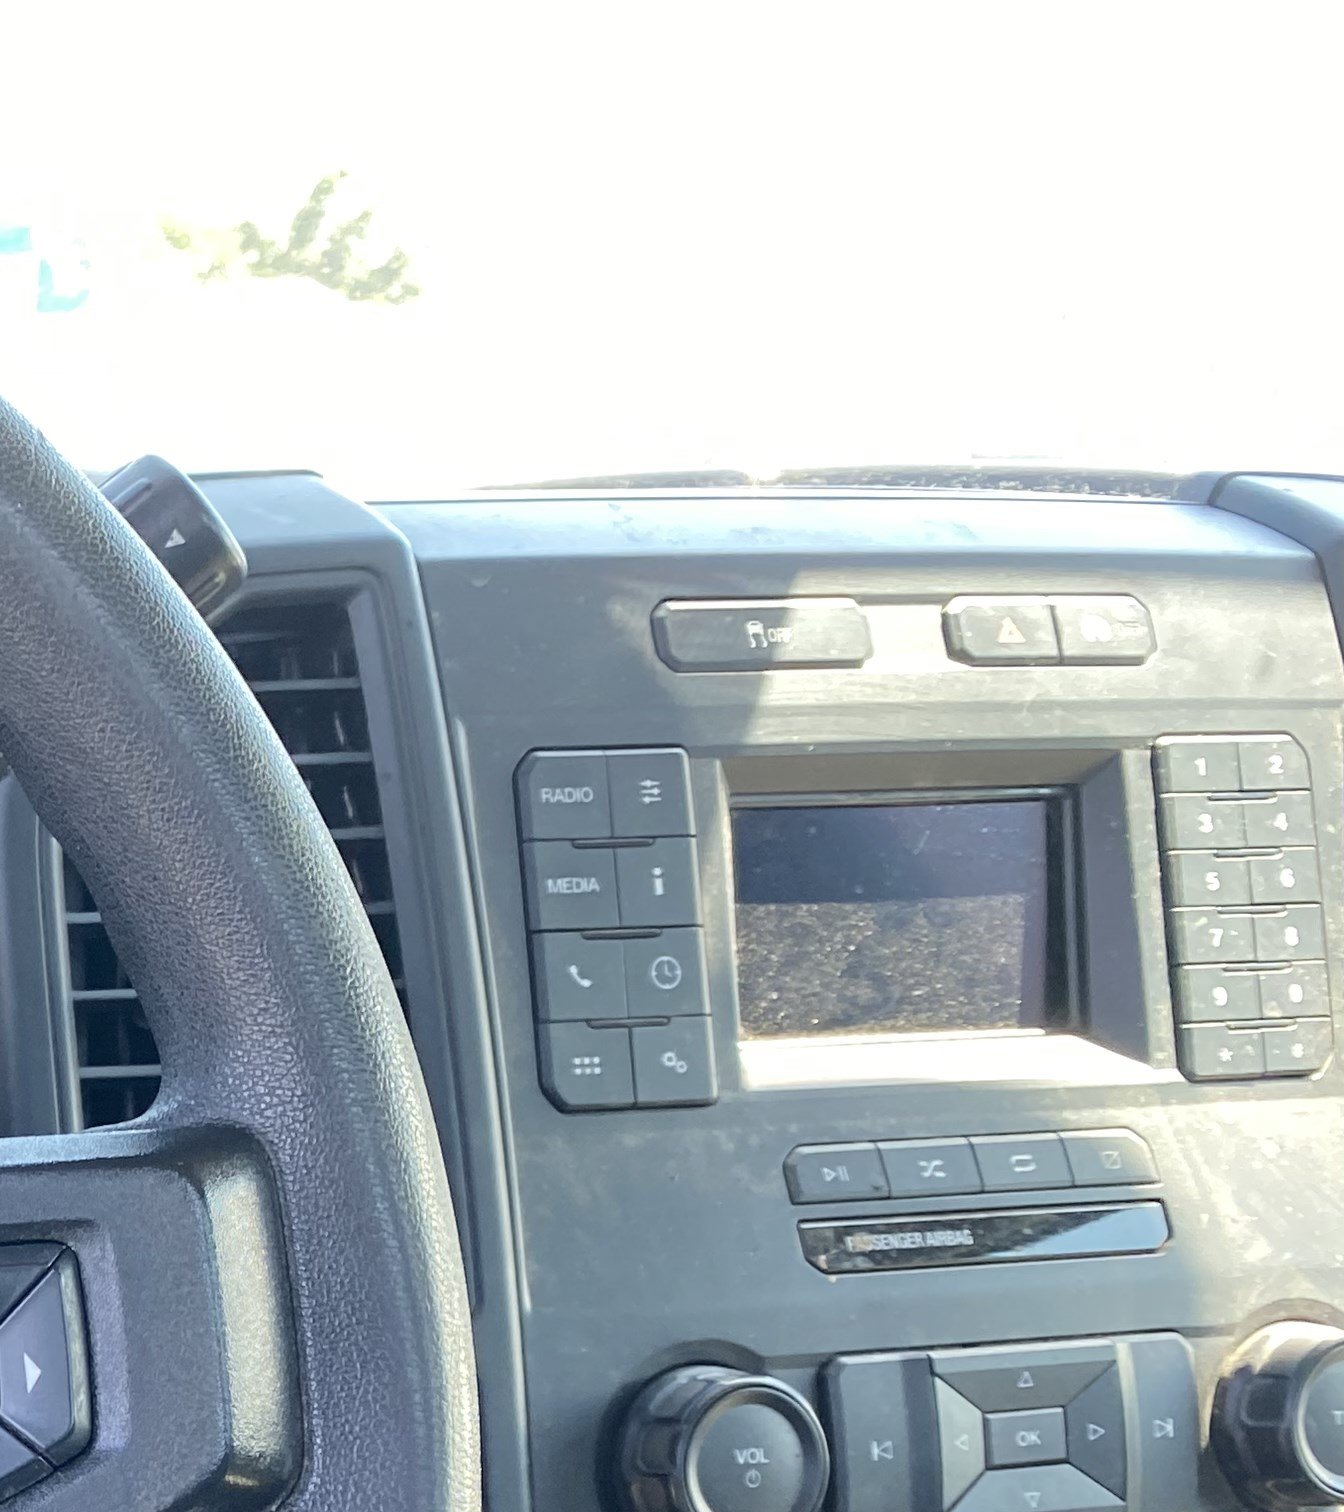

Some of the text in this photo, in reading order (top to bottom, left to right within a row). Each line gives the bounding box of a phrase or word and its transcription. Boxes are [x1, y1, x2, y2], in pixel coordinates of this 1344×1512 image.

[1195, 757, 1207, 776] 1
[1268, 754, 1285, 775] 2
[541, 787, 594, 804] RADIO
[1197, 813, 1214, 834] 3
[546, 877, 600, 894] MEDIA
[1205, 870, 1220, 891] 5
[1279, 868, 1295, 888] 6
[1209, 927, 1224, 947] 7
[1212, 985, 1228, 1006] 9
[926, 1229, 975, 1248] AIRBAG
[1016, 1430, 1041, 1447] OK
[734, 1448, 770, 1465] VOL
